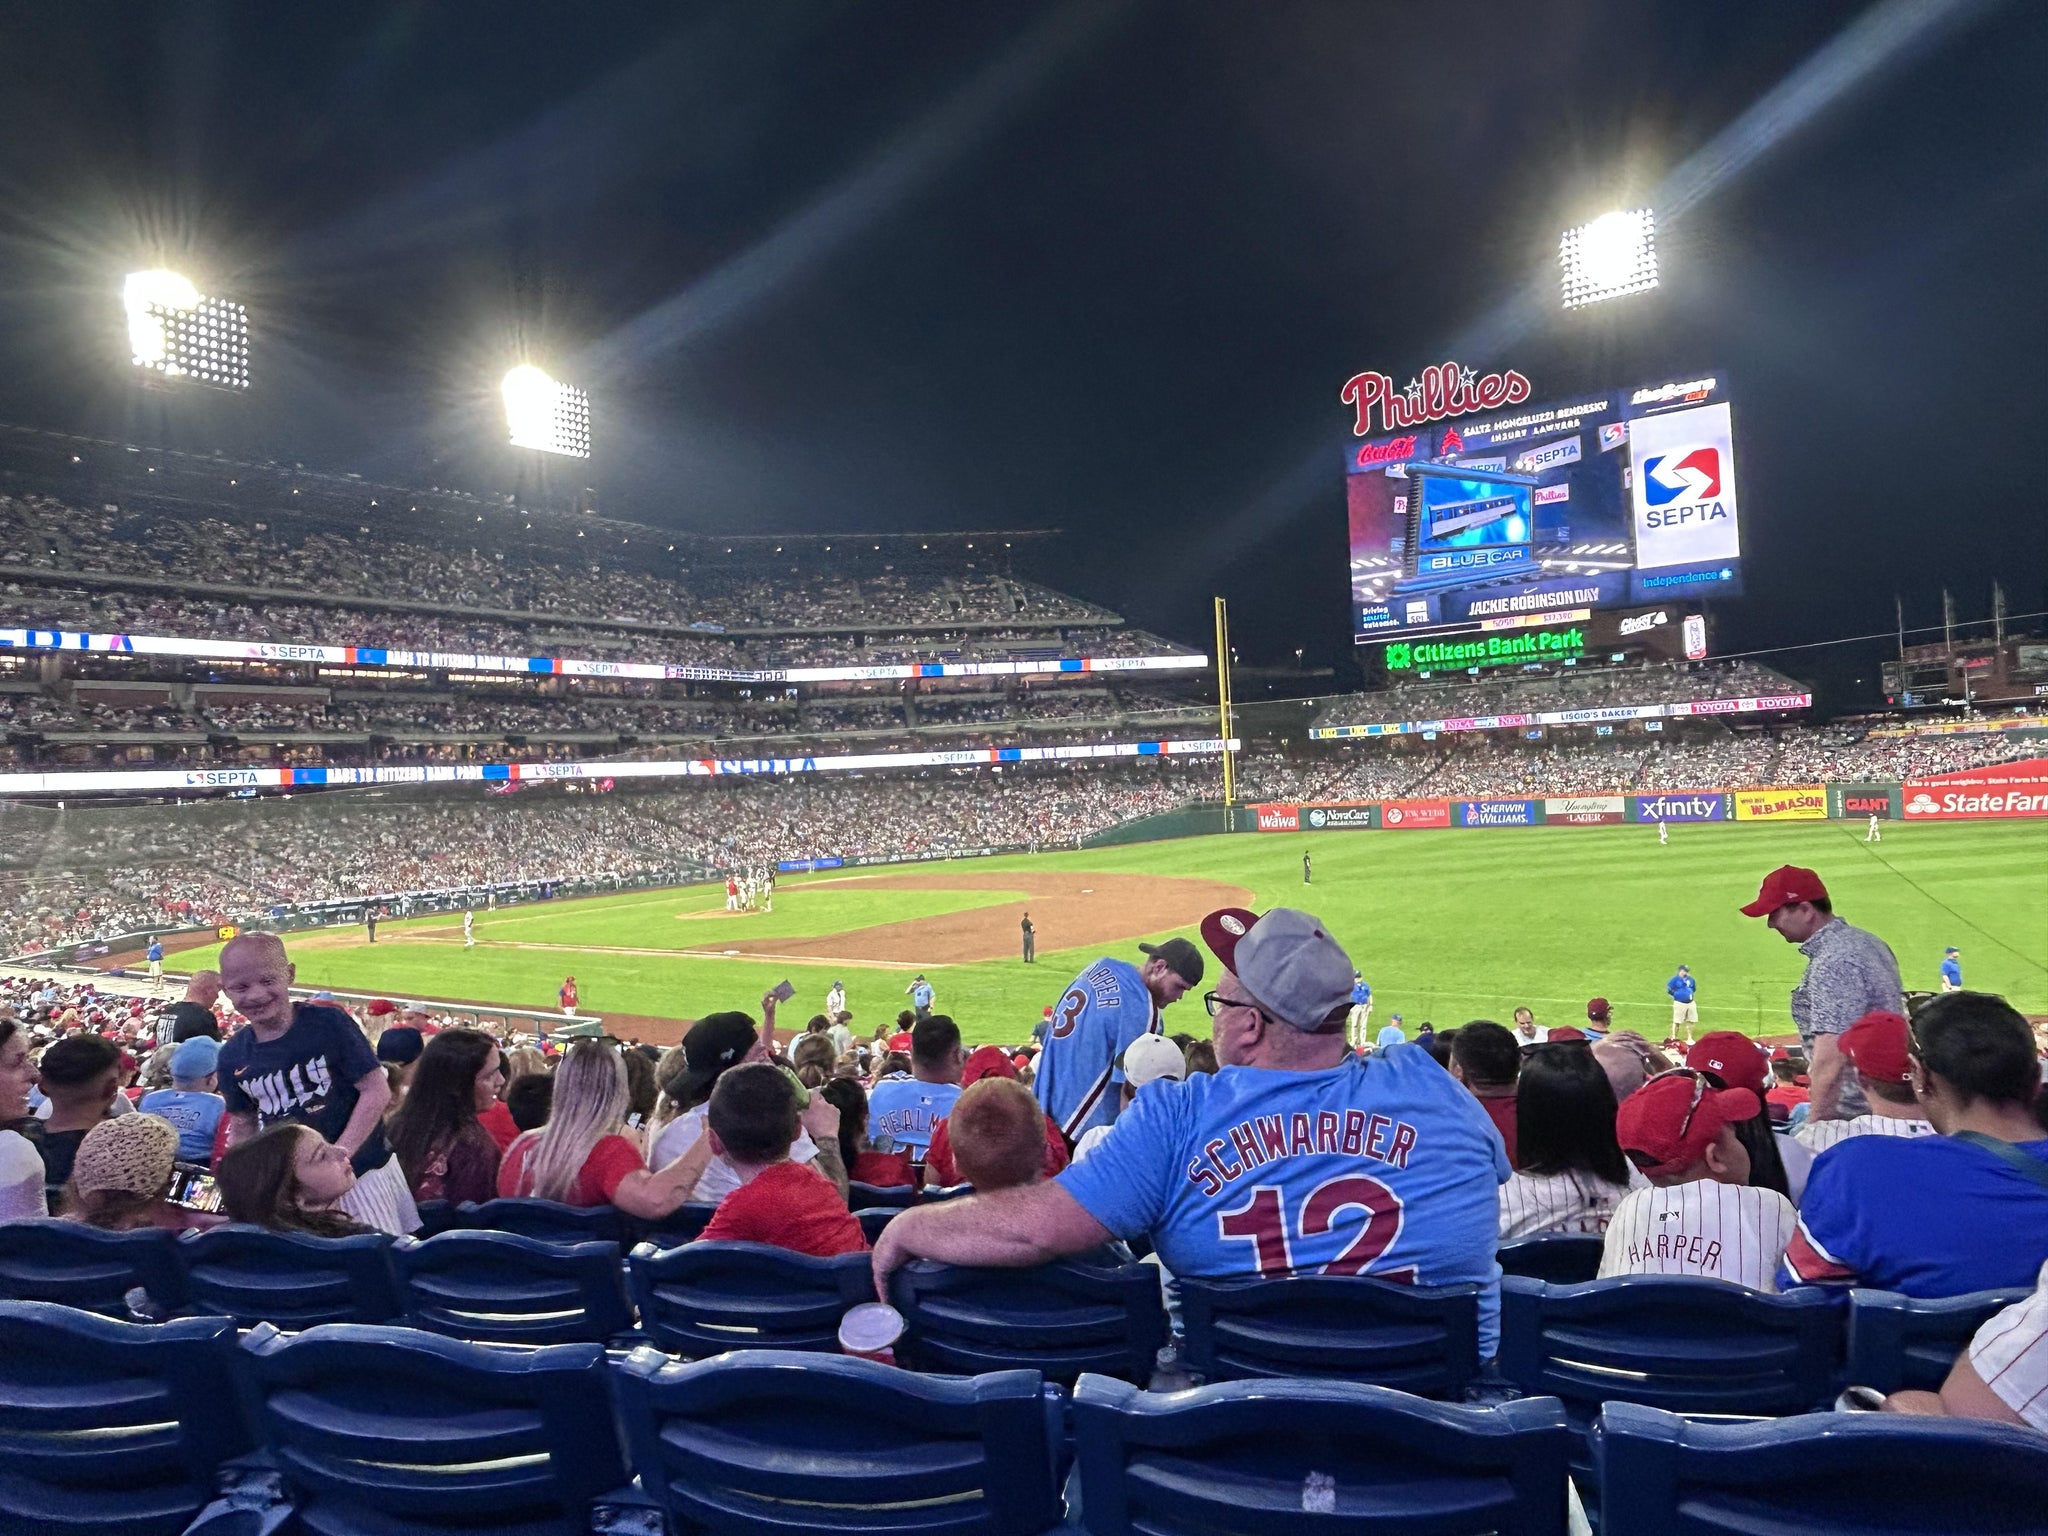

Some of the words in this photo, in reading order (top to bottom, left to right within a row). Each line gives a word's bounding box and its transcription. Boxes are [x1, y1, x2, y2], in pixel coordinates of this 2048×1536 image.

[1341, 361, 1531, 436] Phillies
[1535, 445, 1579, 465] SEPTA
[1646, 501, 1728, 528] SEPTA
[1431, 552, 1488, 570] BLUE
[1490, 549, 1523, 563] CAR
[1643, 571, 1717, 588] Independence
[1468, 597, 1510, 616] JACKIE
[1510, 593, 1573, 612] ROBINSON
[1574, 588, 1599, 603] DAY
[279, 646, 325, 659] SEPTA
[1414, 641, 1486, 663] Citizens
[1488, 633, 1537, 656] Bank
[1539, 628, 1584, 651] Park
[588, 663, 620, 675] SEPTA
[1694, 702, 1735, 712] TOYOTA
[1759, 697, 1804, 708] TOYOTA
[206, 772, 258, 785] SEPTA
[548, 765, 583, 777] SEPTA
[1480, 803, 1526, 813] SHERWIN
[1642, 797, 1717, 819] xfinity
[1845, 798, 1889, 811] GIANT
[1259, 815, 1297, 828] Wawa
[1327, 809, 1370, 821] NovaCare
[1052, 987, 1088, 1039] 3
[1188, 1109, 1418, 1197] SCHWARBER
[1217, 1173, 1420, 1285] 12
[1628, 1234, 1722, 1271] HARPER
